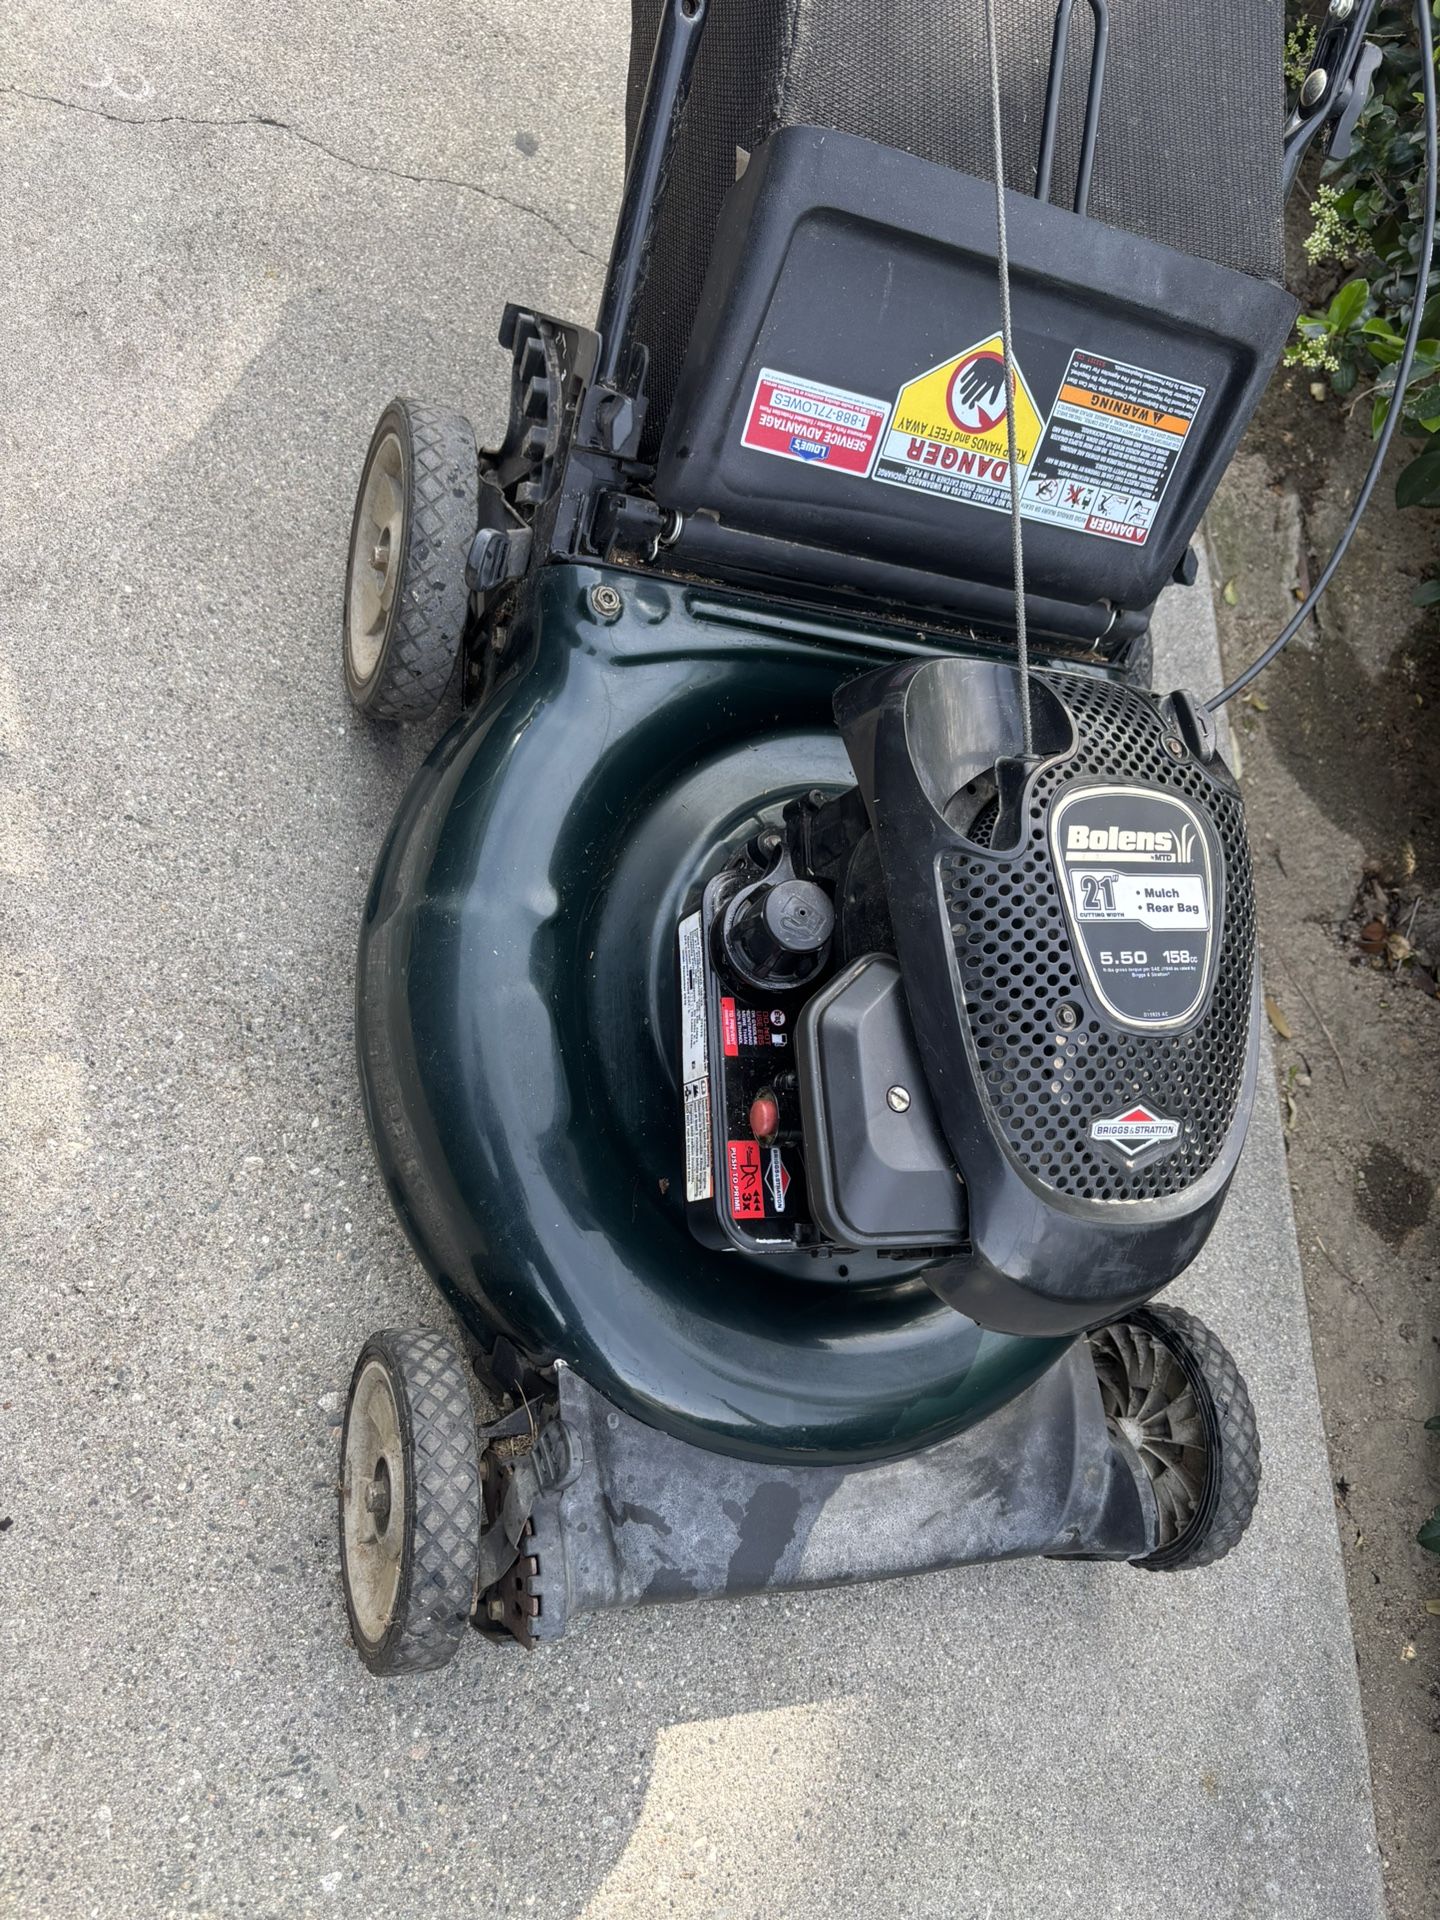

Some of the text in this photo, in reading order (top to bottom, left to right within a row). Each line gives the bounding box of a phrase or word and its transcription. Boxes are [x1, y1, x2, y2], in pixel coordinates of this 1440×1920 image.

[772, 392, 867, 428] 1-888-77LOWES
[1089, 394, 1150, 420] WARNING
[757, 412, 867, 452] SERVICE ADVANTAGE
[896, 416, 1027, 461] KEP HANDS and FEET AWAY
[791, 437, 827, 458] LOWE'S
[904, 436, 1009, 483] DANGER
[1088, 516, 1135, 538] DANGER
[1066, 824, 1172, 851] Bolens
[1144, 888, 1179, 898] Mulch
[1146, 902, 1199, 914] Rear Bag
[1099, 950, 1147, 964] 5.50
[1162, 950, 1198, 963] 158cc
[1096, 1125, 1174, 1135] BRIGGS&STRATTON
[731, 1172, 738, 1183] TO
[773, 1149, 782, 1208] BRIGGS&STRATTON
[732, 1185, 740, 1211] PRIME
[741, 1192, 752, 1210] 3x
